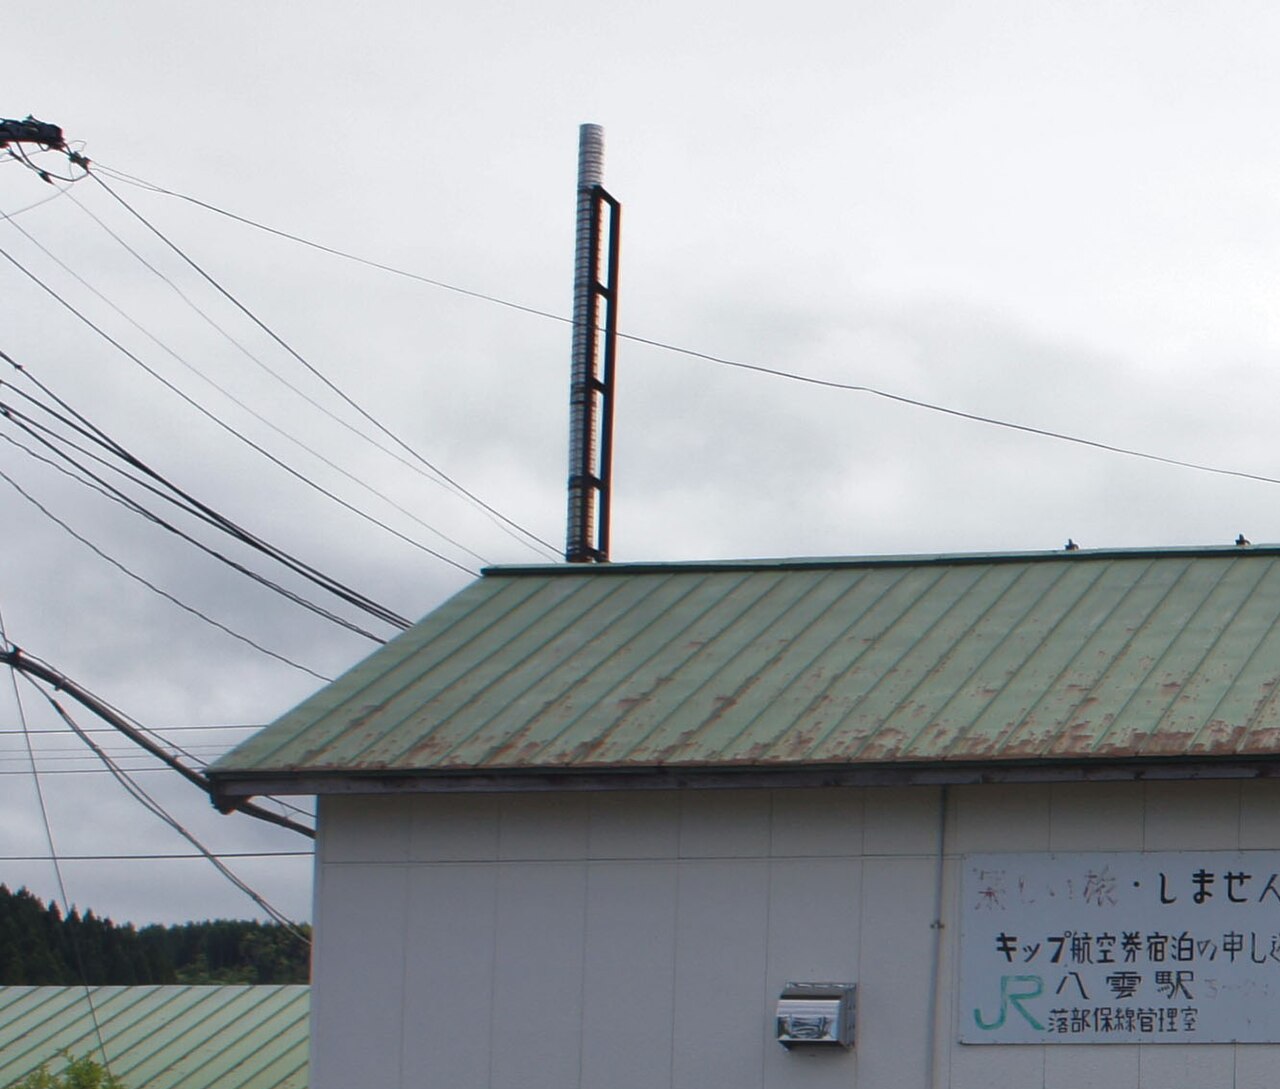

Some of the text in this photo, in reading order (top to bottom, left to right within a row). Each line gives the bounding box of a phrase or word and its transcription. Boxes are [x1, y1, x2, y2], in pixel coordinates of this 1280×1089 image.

[974, 974, 1045, 1031] JR
[1056, 970, 1194, 1001] 八雲駅
[1047, 1006, 1199, 1033] 落部保線管理室
